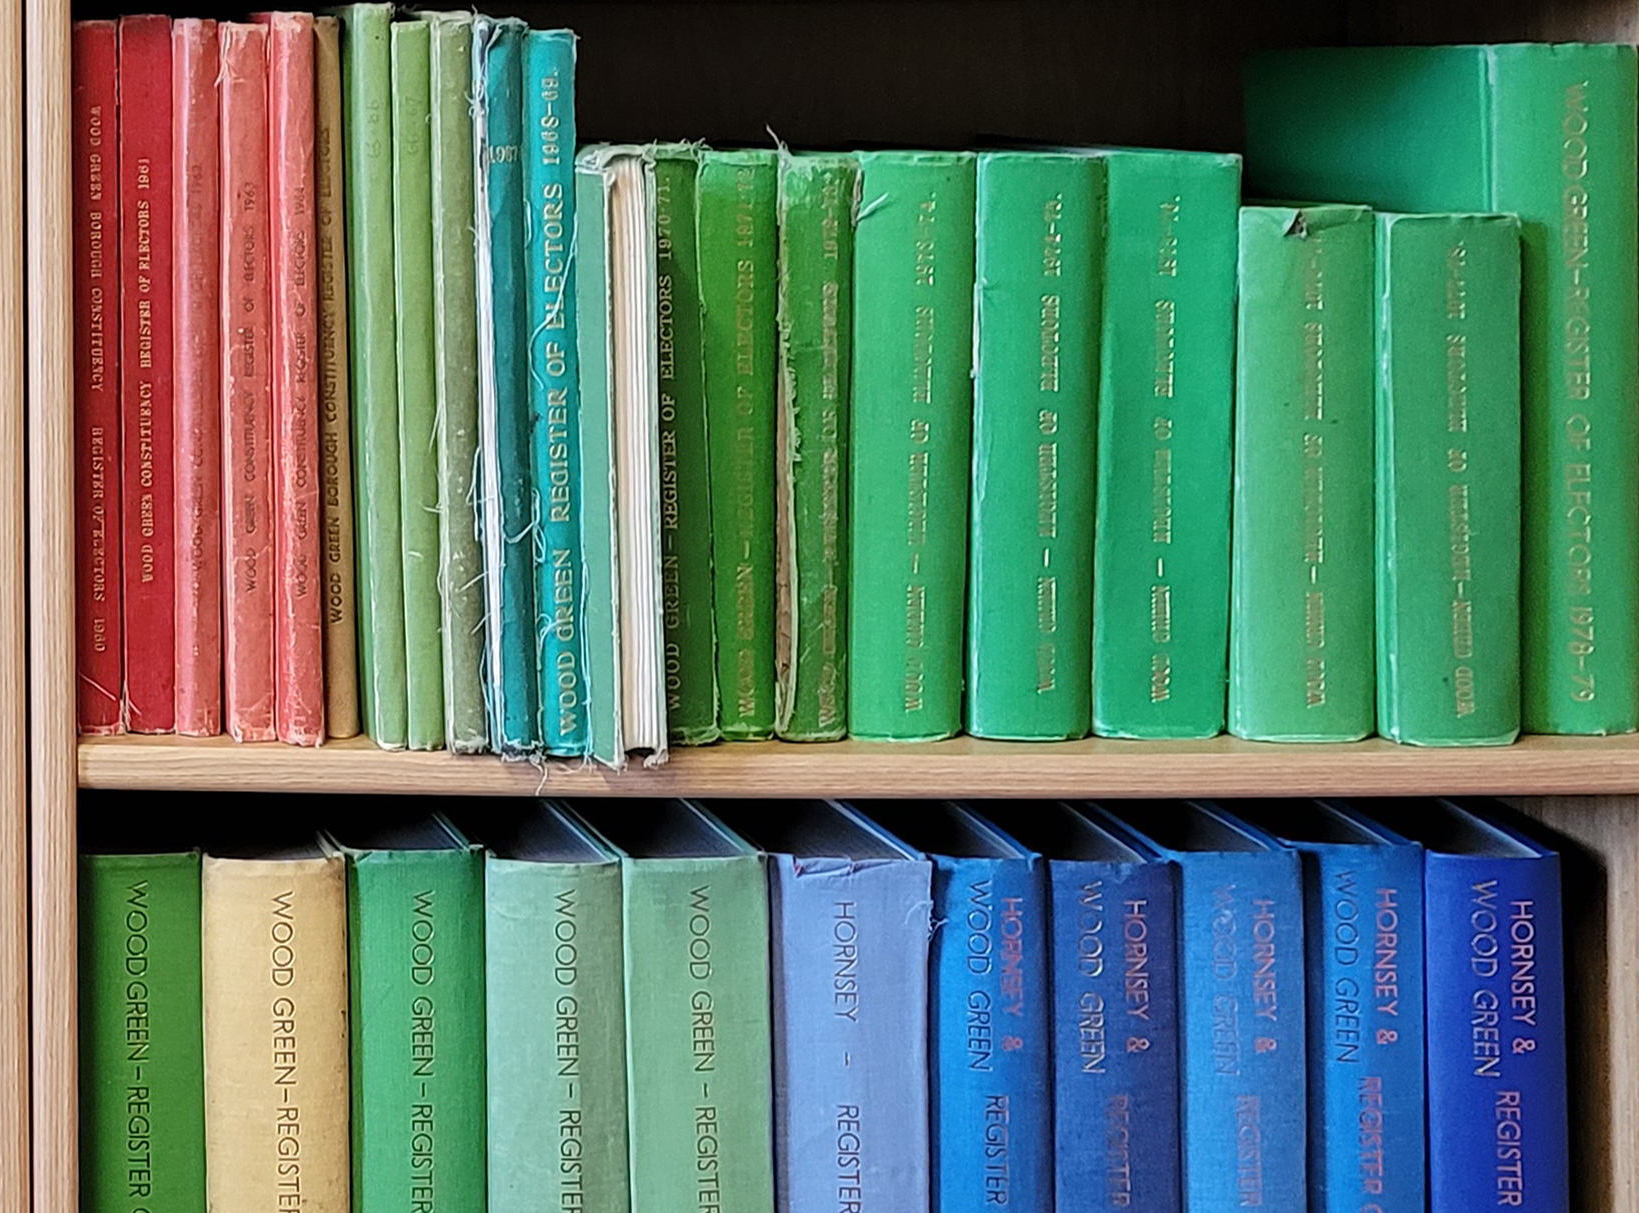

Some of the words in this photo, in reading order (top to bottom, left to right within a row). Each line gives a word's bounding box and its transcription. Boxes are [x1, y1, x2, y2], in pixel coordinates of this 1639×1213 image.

[136, 158, 150, 190] 1961
[137, 200, 151, 270] ELECTORS
[542, 183, 567, 329] ELECTORS
[138, 276, 150, 293] OF
[658, 274, 675, 380] ELECTORS
[138, 300, 152, 368] REGISTER
[544, 341, 567, 377] OF
[140, 380, 154, 487] CONSTITUENCY
[660, 394, 676, 422] OF
[546, 387, 571, 521] REGISTER
[660, 431, 678, 530] REGISTER
[140, 545, 154, 582] WOOD
[552, 549, 576, 641] GREEN
[663, 555, 680, 629] GREEN
[555, 651, 579, 736] WOOD
[664, 643, 682, 710] WOOD
[125, 880, 149, 976] WOOD
[270, 891, 296, 987] WOOD
[411, 891, 435, 986] WOOD
[552, 889, 577, 986] WOOD
[689, 885, 712, 980] WOOD
[832, 900, 859, 1023] HORNSEY
[966, 879, 993, 975] WOOD
[1470, 879, 1499, 978] WOOD
[1509, 900, 1538, 1026] HORNSEY
[411, 995, 435, 1077] GREEN
[554, 995, 580, 1077] GREEN
[689, 990, 716, 1073] GREEN
[965, 990, 993, 1073] GREEN
[1000, 1036, 1024, 1052] &
[1471, 989, 1502, 1078] GREEN
[1511, 1037, 1537, 1055] &
[983, 1095, 1010, 1205] REGISTER
[1495, 1091, 1523, 1206] REGISTER
